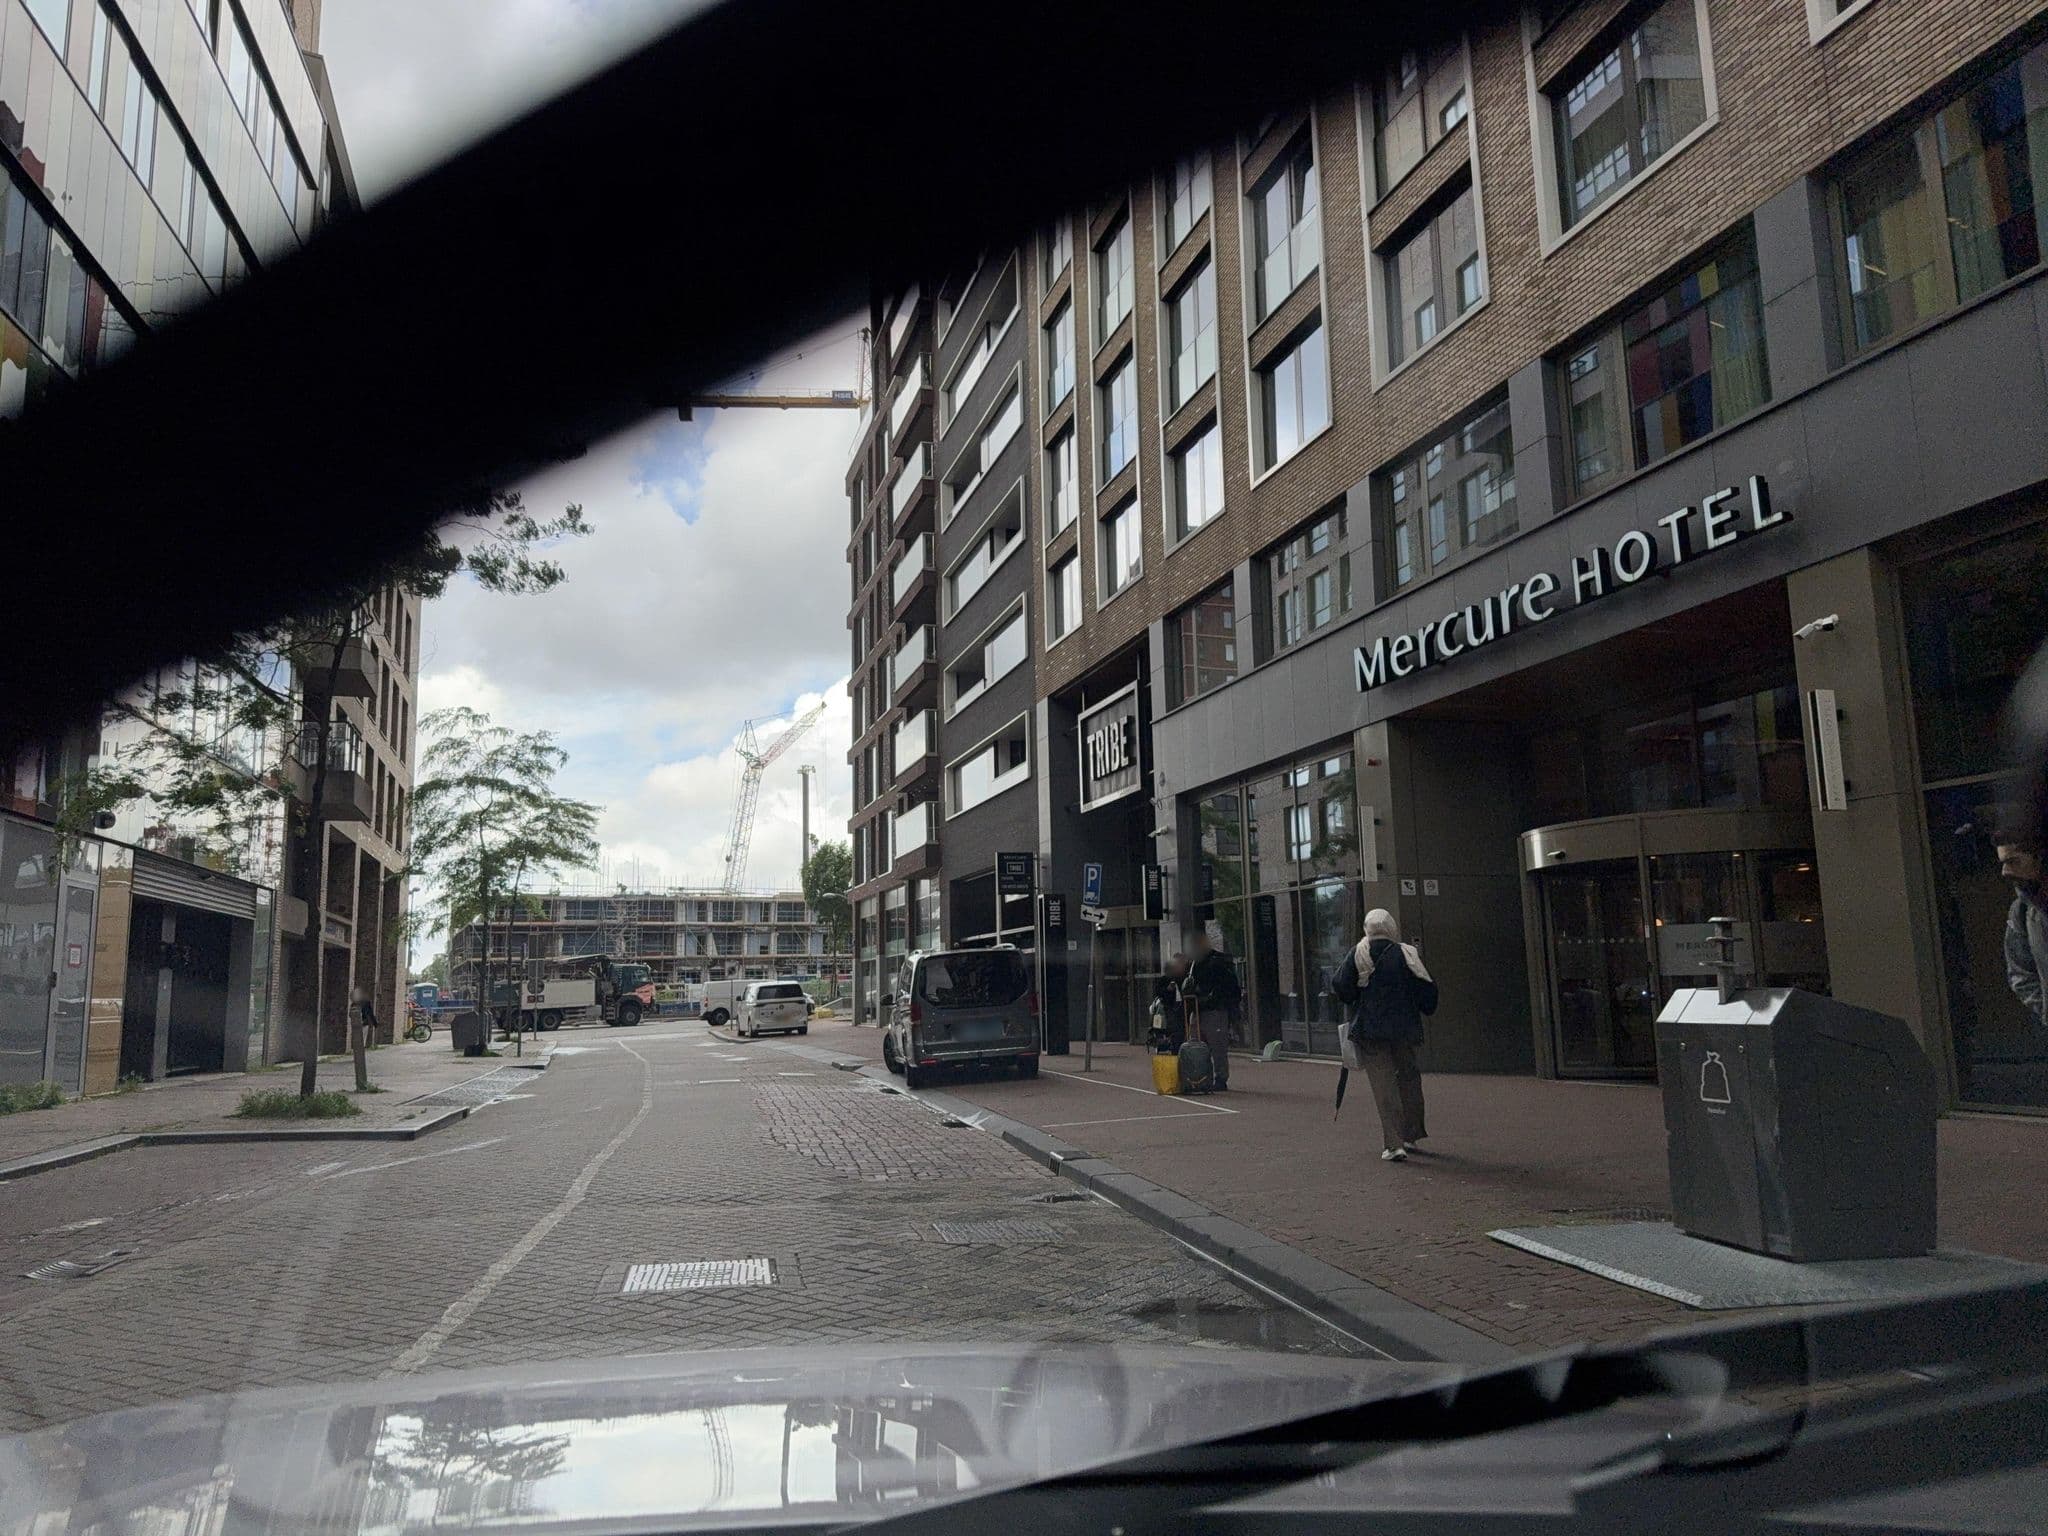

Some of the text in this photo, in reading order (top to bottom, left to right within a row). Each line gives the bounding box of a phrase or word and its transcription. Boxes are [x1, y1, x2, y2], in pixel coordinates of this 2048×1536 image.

[1354, 475, 1790, 693] Mercure HOTEL
[1086, 715, 1133, 782] TRIBE
[1087, 867, 1098, 888] P
[1148, 869, 1159, 891] TRIBE
[1049, 899, 1062, 928] TRIBE
